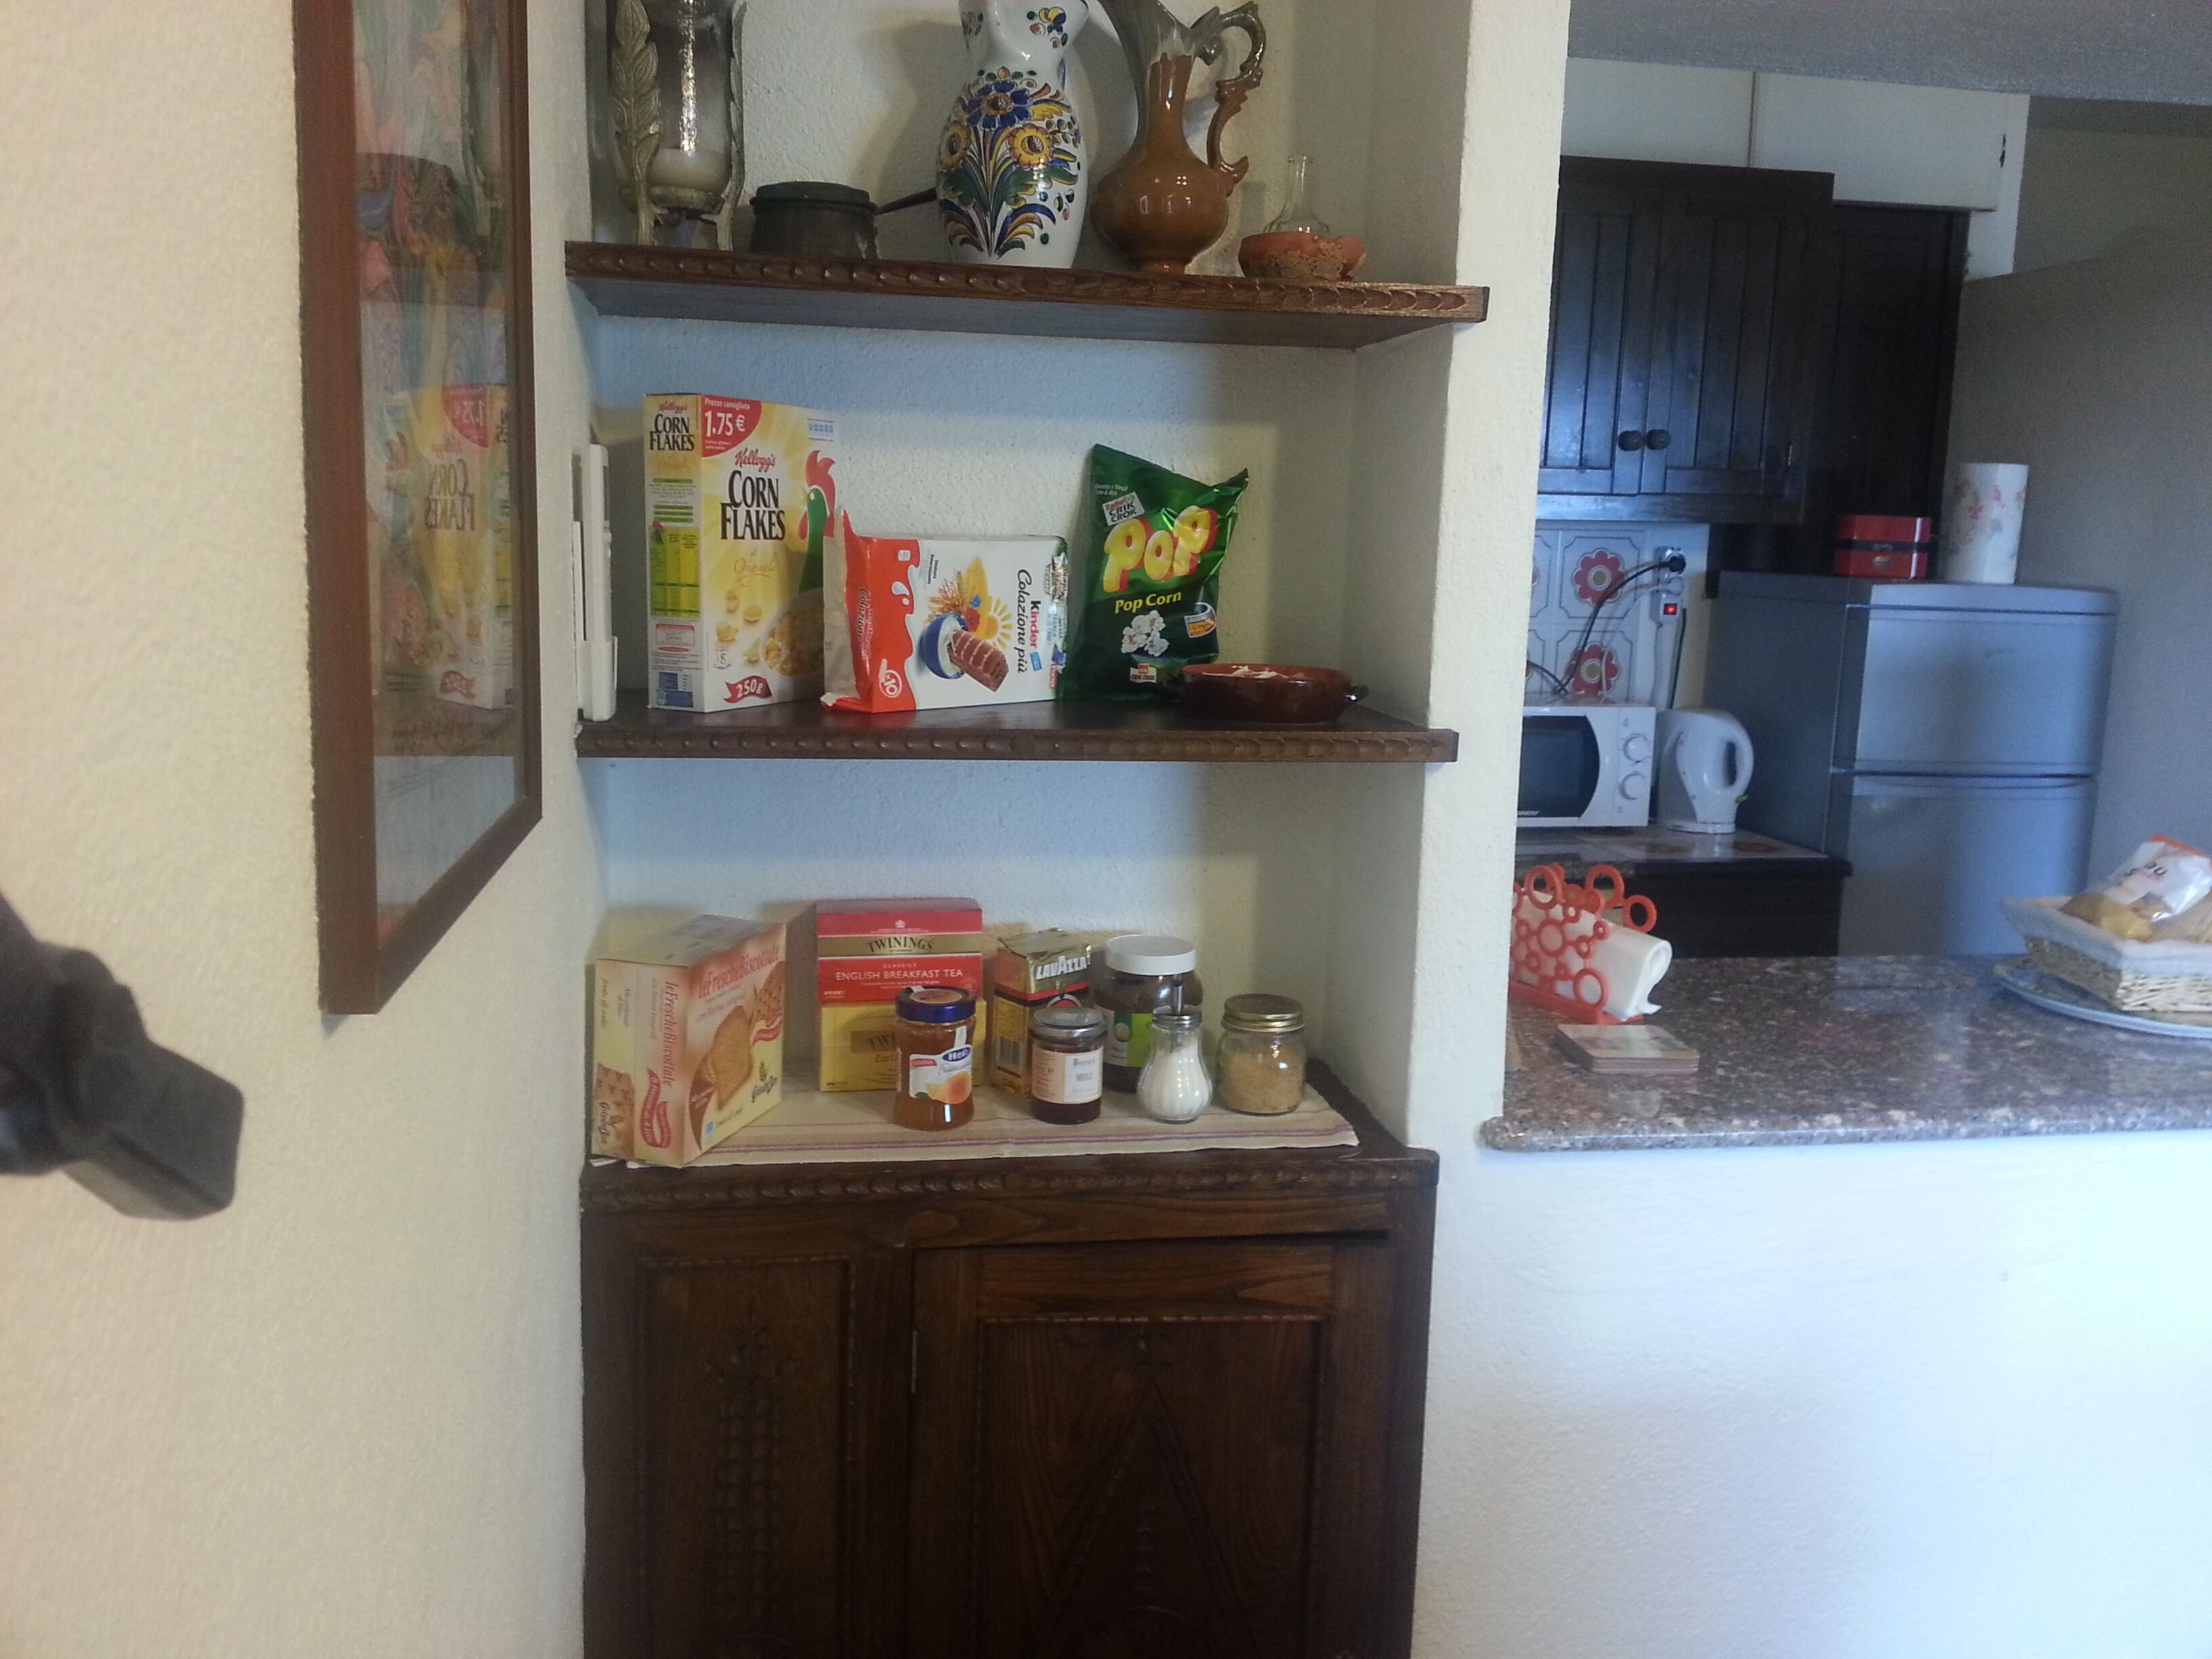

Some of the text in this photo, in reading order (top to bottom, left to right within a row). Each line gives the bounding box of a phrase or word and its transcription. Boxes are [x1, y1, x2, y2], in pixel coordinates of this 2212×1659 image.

[654, 413, 690, 434] CORN
[704, 410, 733, 437] 1.75
[649, 431, 695, 451] FLAKES
[735, 447, 775, 472] Kellogg's
[729, 470, 779, 508] CORN
[1109, 501, 1134, 516] CRIK
[1111, 508, 1136, 523] CROK
[720, 502, 786, 541] FLAKES
[1017, 569, 1032, 645] Colazione
[1115, 592, 1182, 614] Pop Corn
[1030, 600, 1041, 649] Kinder
[737, 679, 764, 698] 250g
[866, 936, 935, 953] TWININGS
[836, 968, 963, 981] ENGLISH BREAKFAST TEA
[1036, 955, 1088, 981] LAVAZZA
